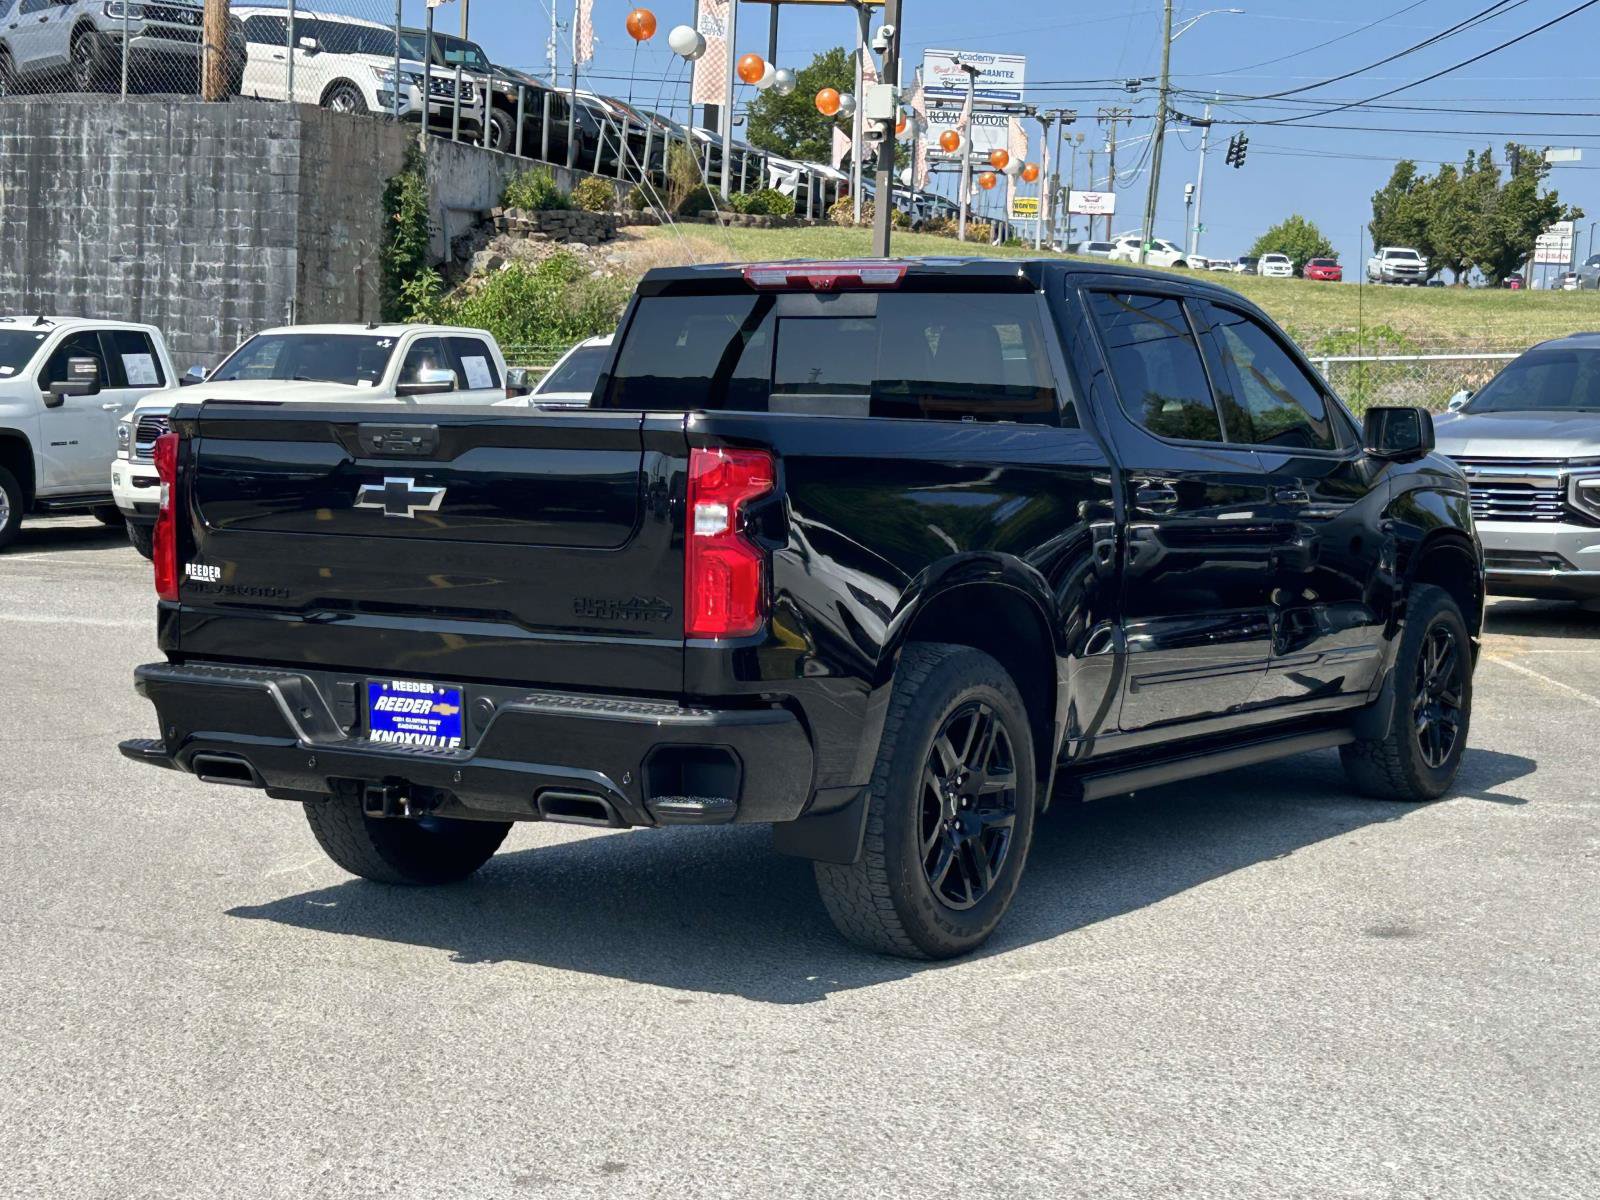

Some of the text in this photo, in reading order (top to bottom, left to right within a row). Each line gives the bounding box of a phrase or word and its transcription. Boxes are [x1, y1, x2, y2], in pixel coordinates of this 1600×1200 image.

[957, 52, 996, 64] Academy
[929, 111, 961, 124] ROYA
[185, 563, 221, 579] REEDER
[392, 681, 434, 693] REEDER
[374, 696, 433, 714] REEDER
[370, 729, 461, 748] KNOXVILLE
